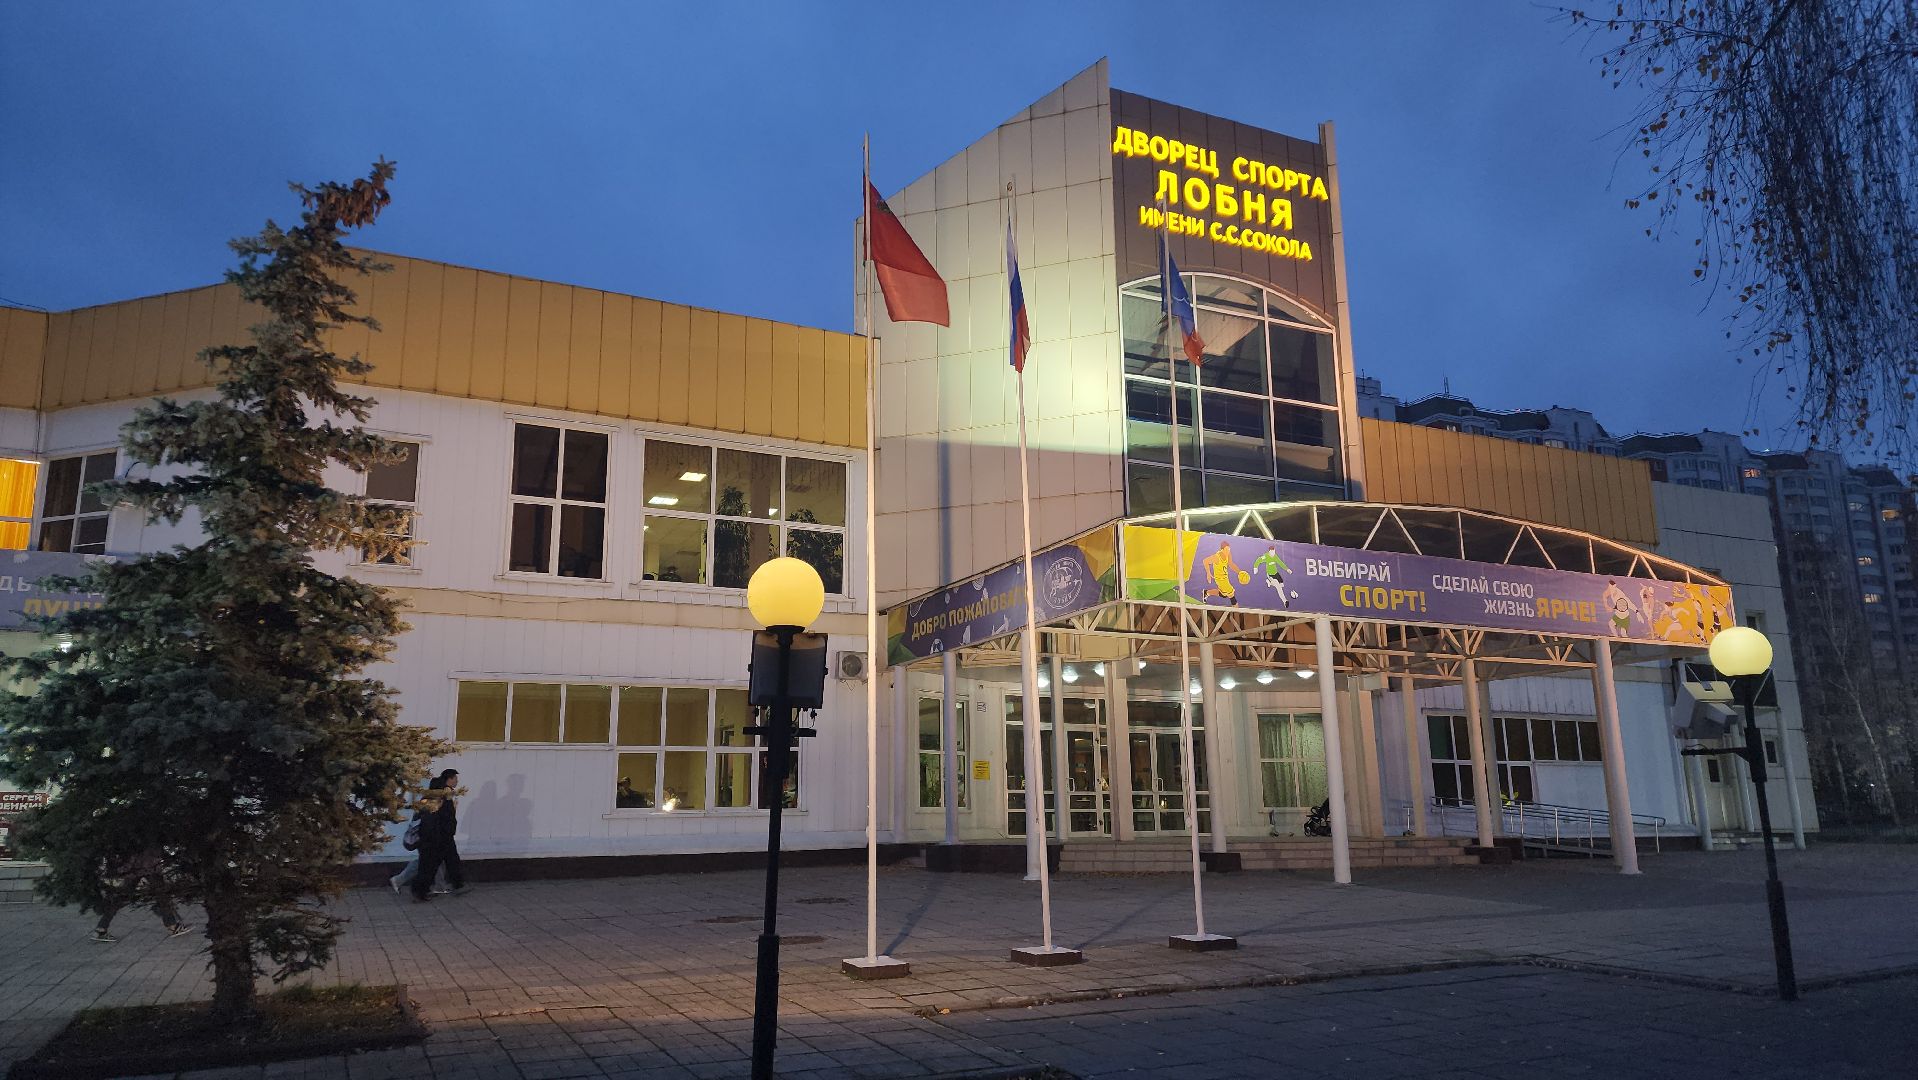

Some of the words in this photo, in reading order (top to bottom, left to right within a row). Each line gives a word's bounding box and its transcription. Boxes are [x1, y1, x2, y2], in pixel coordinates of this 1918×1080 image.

[1113, 126, 1219, 179] ДВОРЕЦ
[1232, 156, 1329, 201] СПОРТА
[1155, 169, 1293, 230] ЛОБНЯ
[1139, 205, 1205, 238] ИМЕНИ
[1209, 222, 1312, 262] С.С.СОКОЛА
[1306, 558, 1391, 582] ВЫБИРАЙ
[1340, 584, 1427, 613] СПОРТ!
[1432, 574, 1489, 594] СДЕЛАЙ
[1493, 580, 1534, 599] СВОЮ
[1484, 599, 1535, 618] ЖИЗНЬ
[1536, 598, 1598, 623] ЯРЧЕ!
[911, 611, 947, 641] ДОБРО
